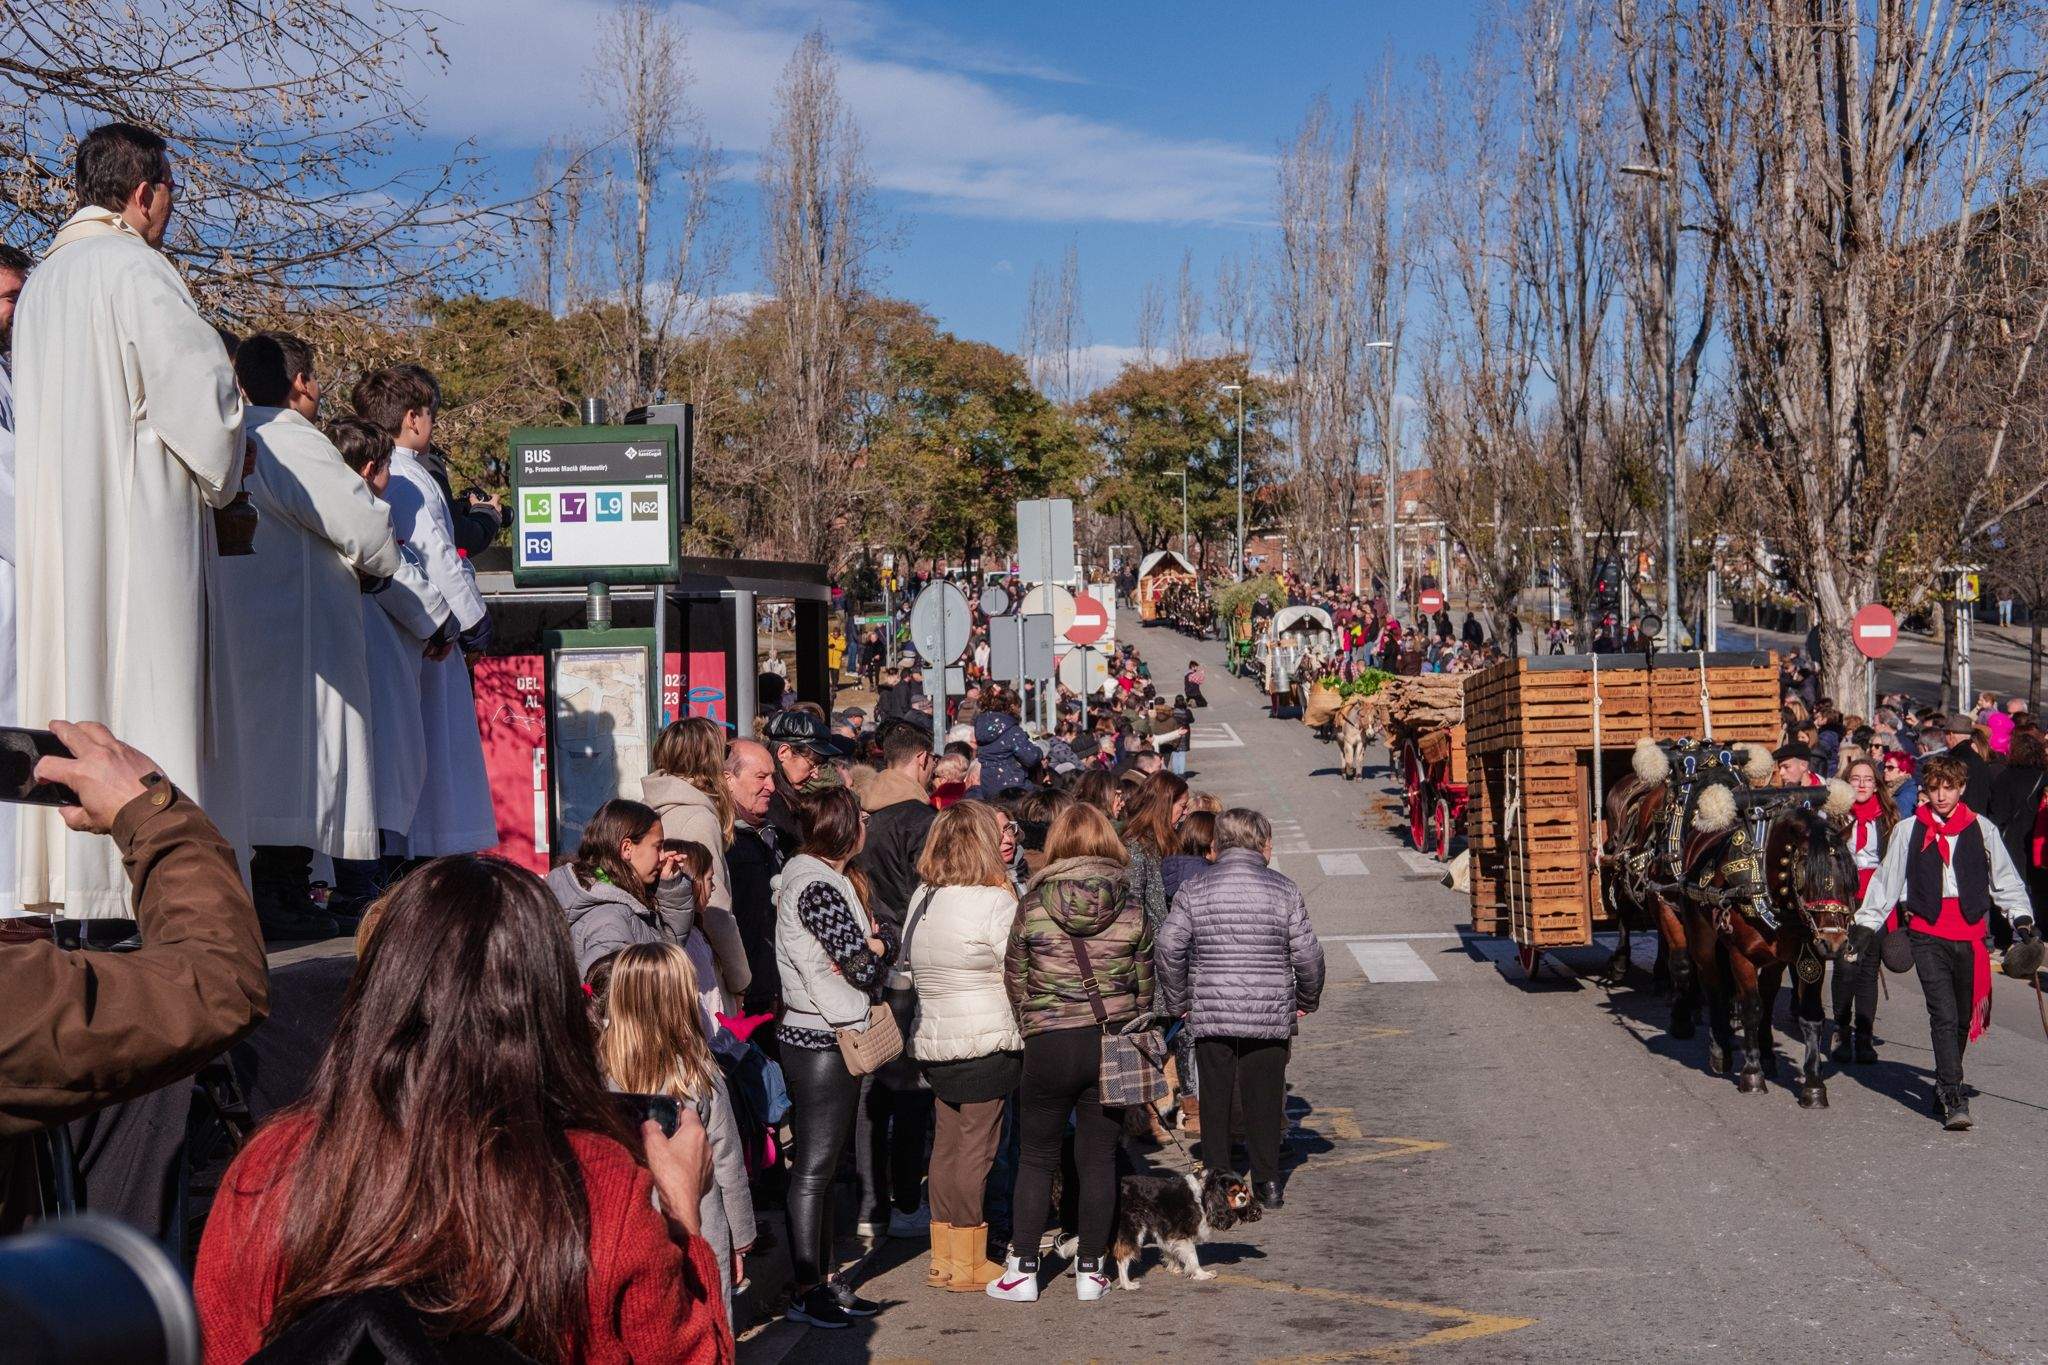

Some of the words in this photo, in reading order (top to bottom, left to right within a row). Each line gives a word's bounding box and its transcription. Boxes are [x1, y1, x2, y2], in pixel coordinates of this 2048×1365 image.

[525, 450, 551, 463] BUS
[527, 499, 550, 516] L3
[561, 498, 586, 515] L7
[597, 497, 622, 515] L9
[632, 502, 658, 513] N62
[527, 539, 551, 554] R9
[517, 677, 540, 690] DEL
[525, 696, 541, 708] AL
